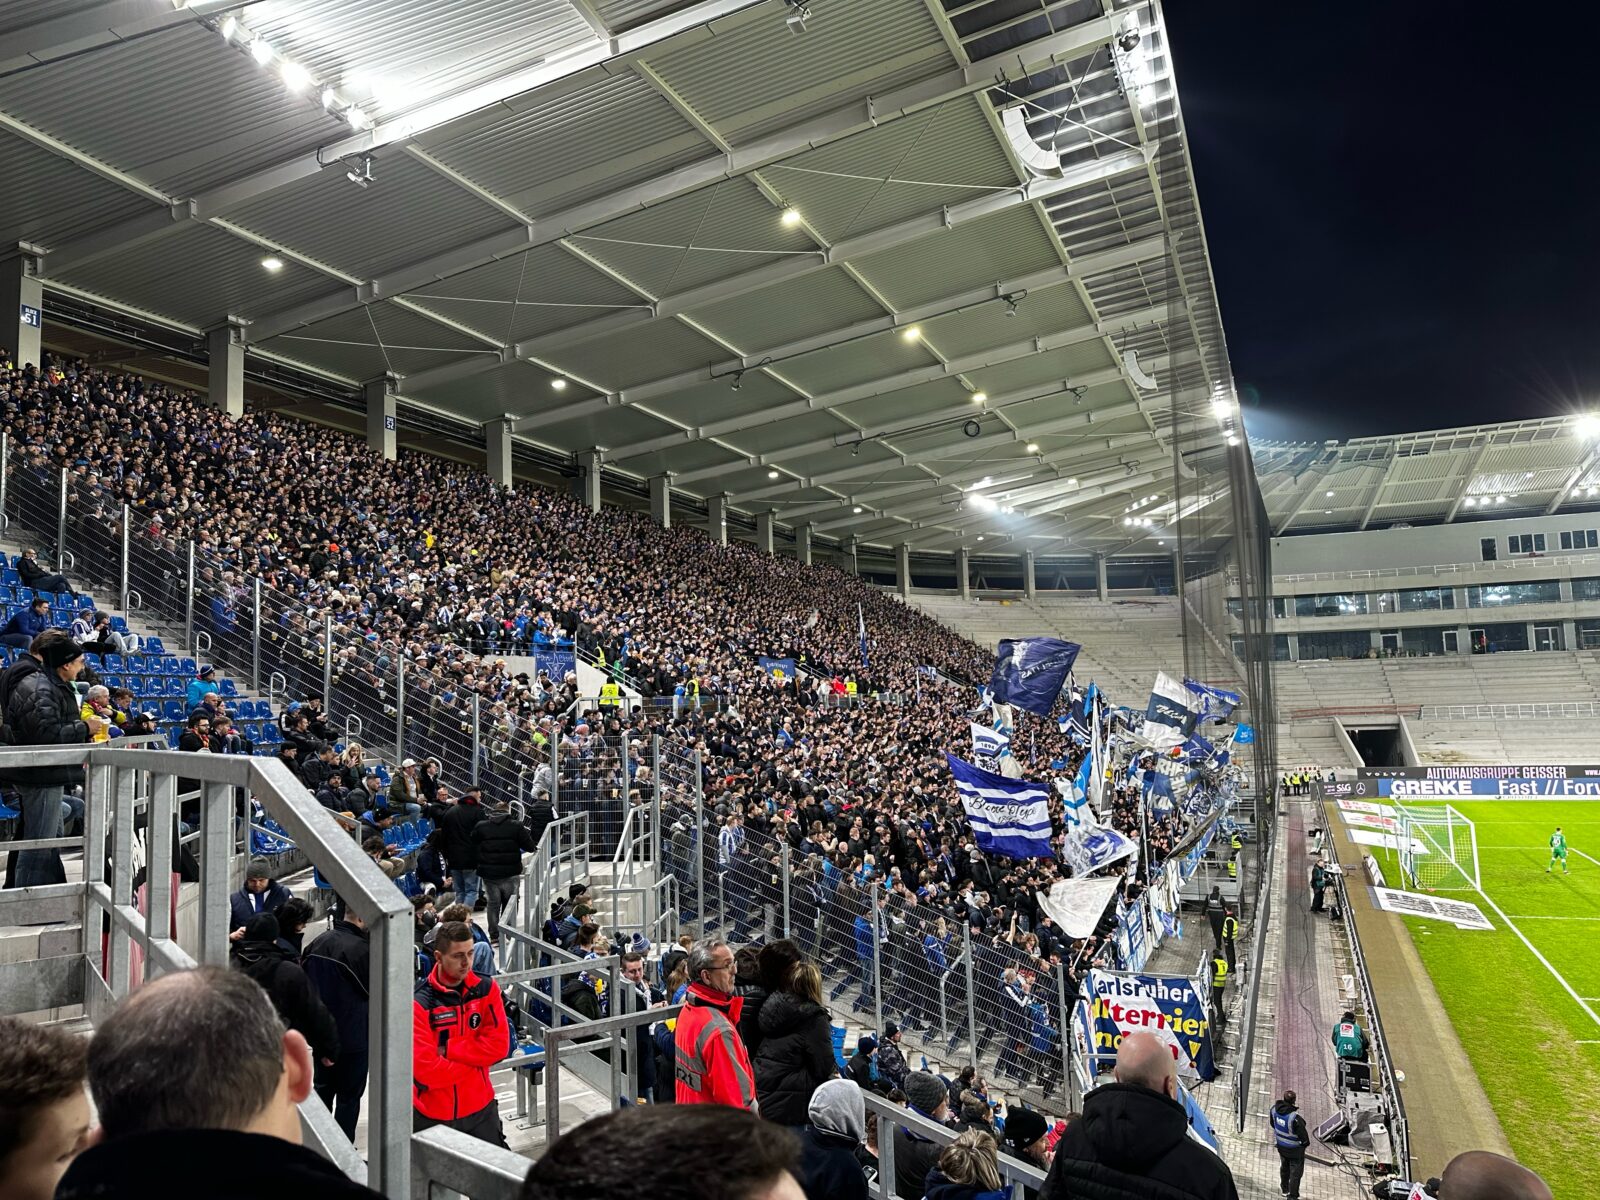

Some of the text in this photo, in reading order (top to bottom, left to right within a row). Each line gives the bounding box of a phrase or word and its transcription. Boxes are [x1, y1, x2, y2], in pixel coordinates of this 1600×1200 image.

[1426, 766, 1520, 780] AUTOHAUSGRUPPE
[1522, 766, 1567, 779] GEISSER
[1391, 780, 1473, 795] GRENKE
[1498, 780, 1538, 795] Fast
[1343, 1043, 1353, 1051] 16
